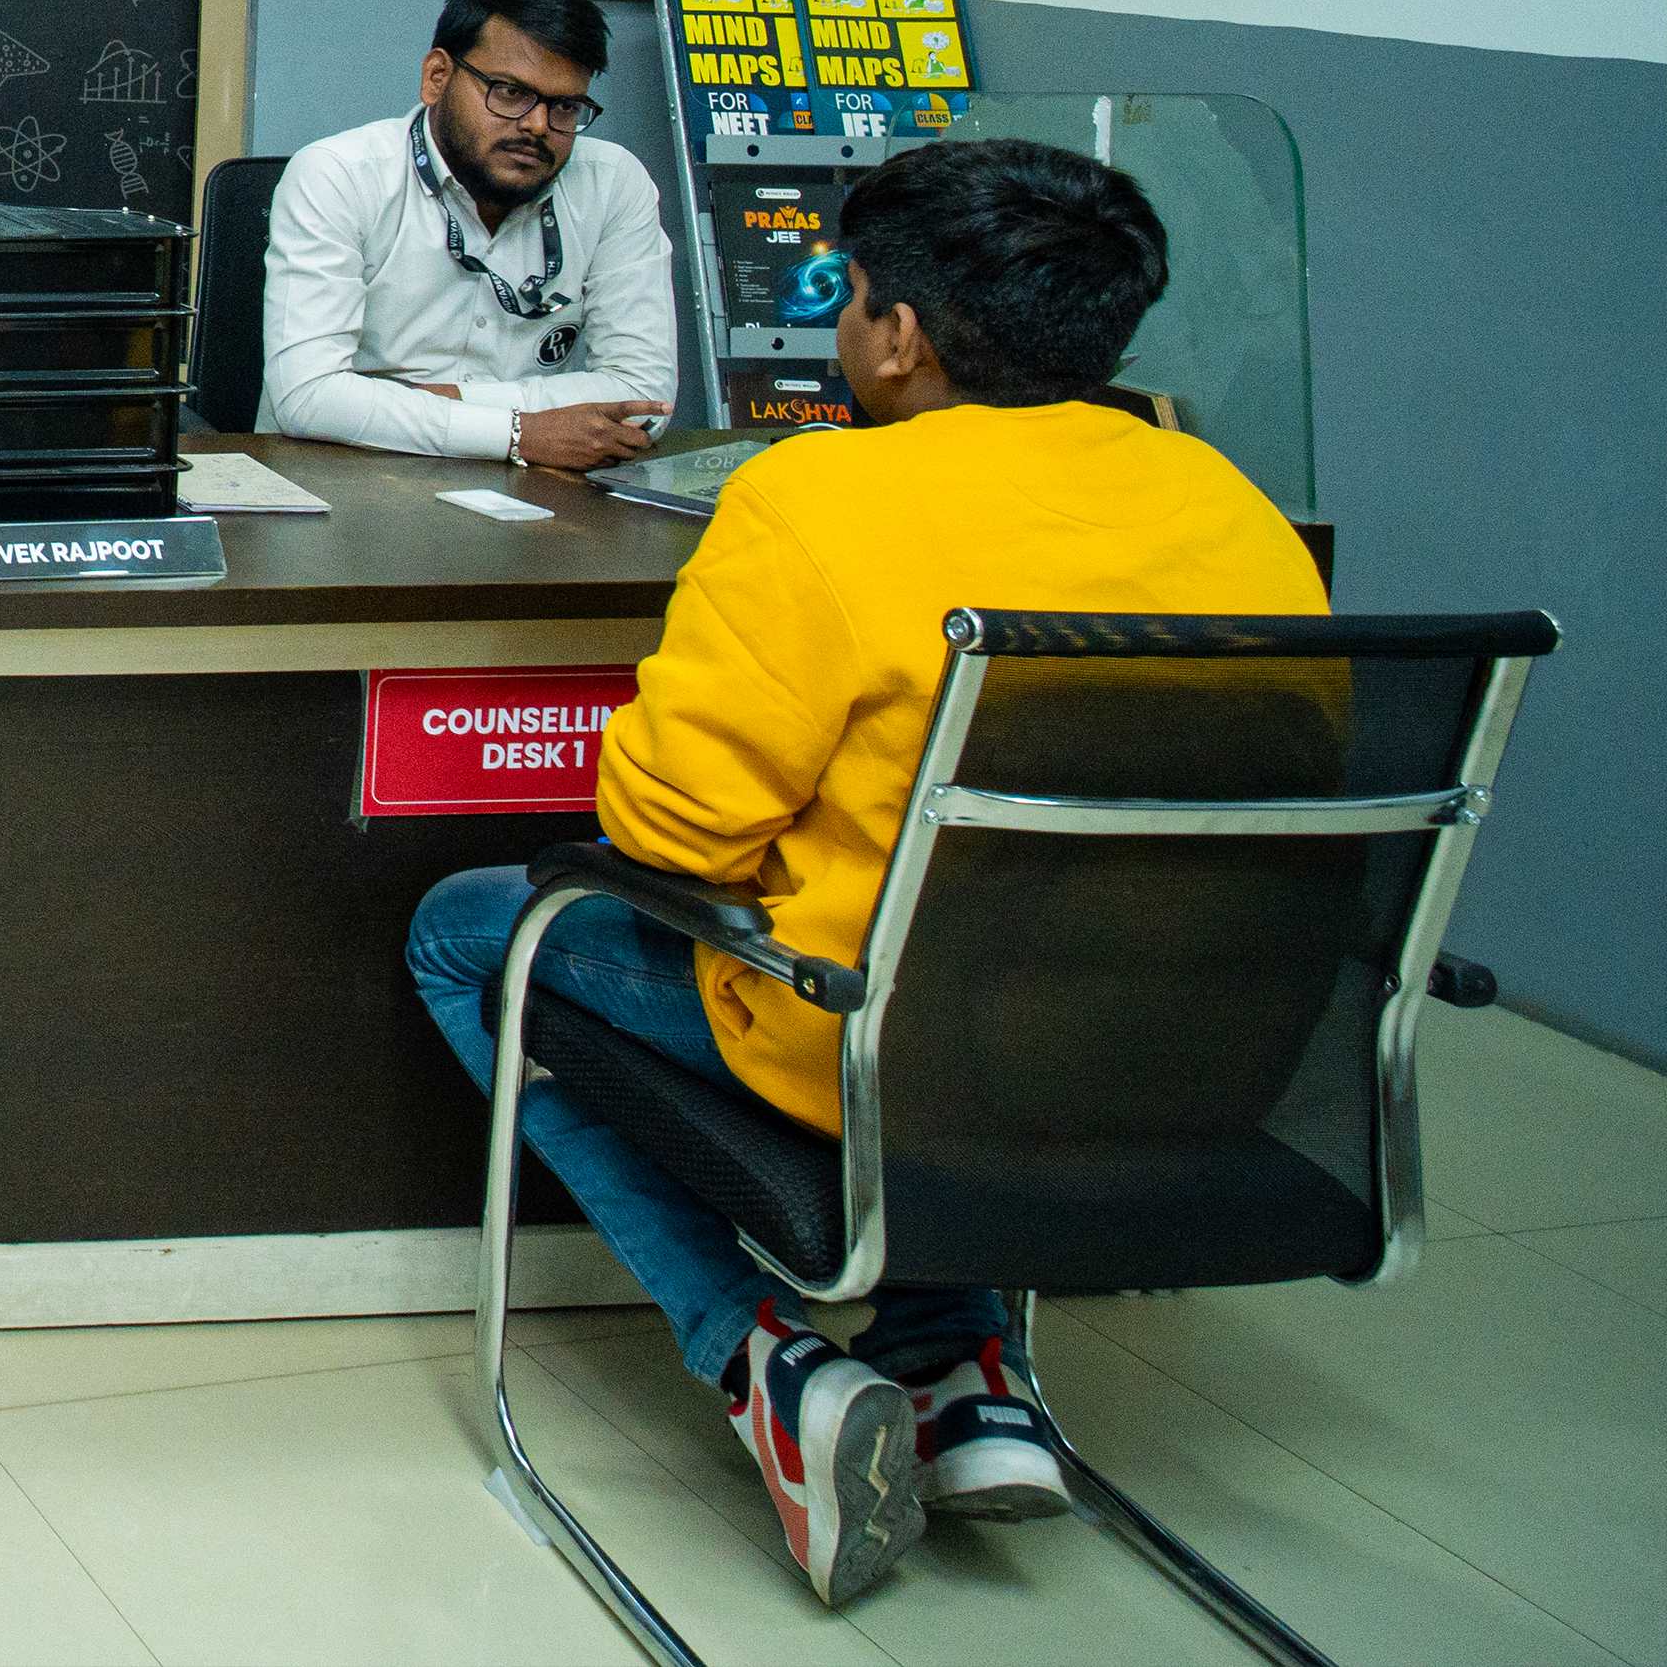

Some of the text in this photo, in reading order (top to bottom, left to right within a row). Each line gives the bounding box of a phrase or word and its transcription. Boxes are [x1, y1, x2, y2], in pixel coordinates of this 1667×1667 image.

[683, 15, 767, 47] MIND
[810, 19, 891, 50] MIND
[689, 53, 781, 87] MAPS
[816, 56, 905, 88] MAPS
[708, 92, 749, 110] FOR
[835, 93, 873, 111] FOR
[711, 112, 769, 135] NEET
[796, 114, 812, 126] CLA
[917, 113, 949, 124] CLASS
[744, 206, 821, 230] PRAYAS
[766, 231, 801, 244] JEE
[750, 398, 852, 424] LAKSHYA
[51, 539, 164, 562] RAJPOOT
[423, 706, 613, 735] COUNSELLI
[483, 741, 584, 769] DESK 1
